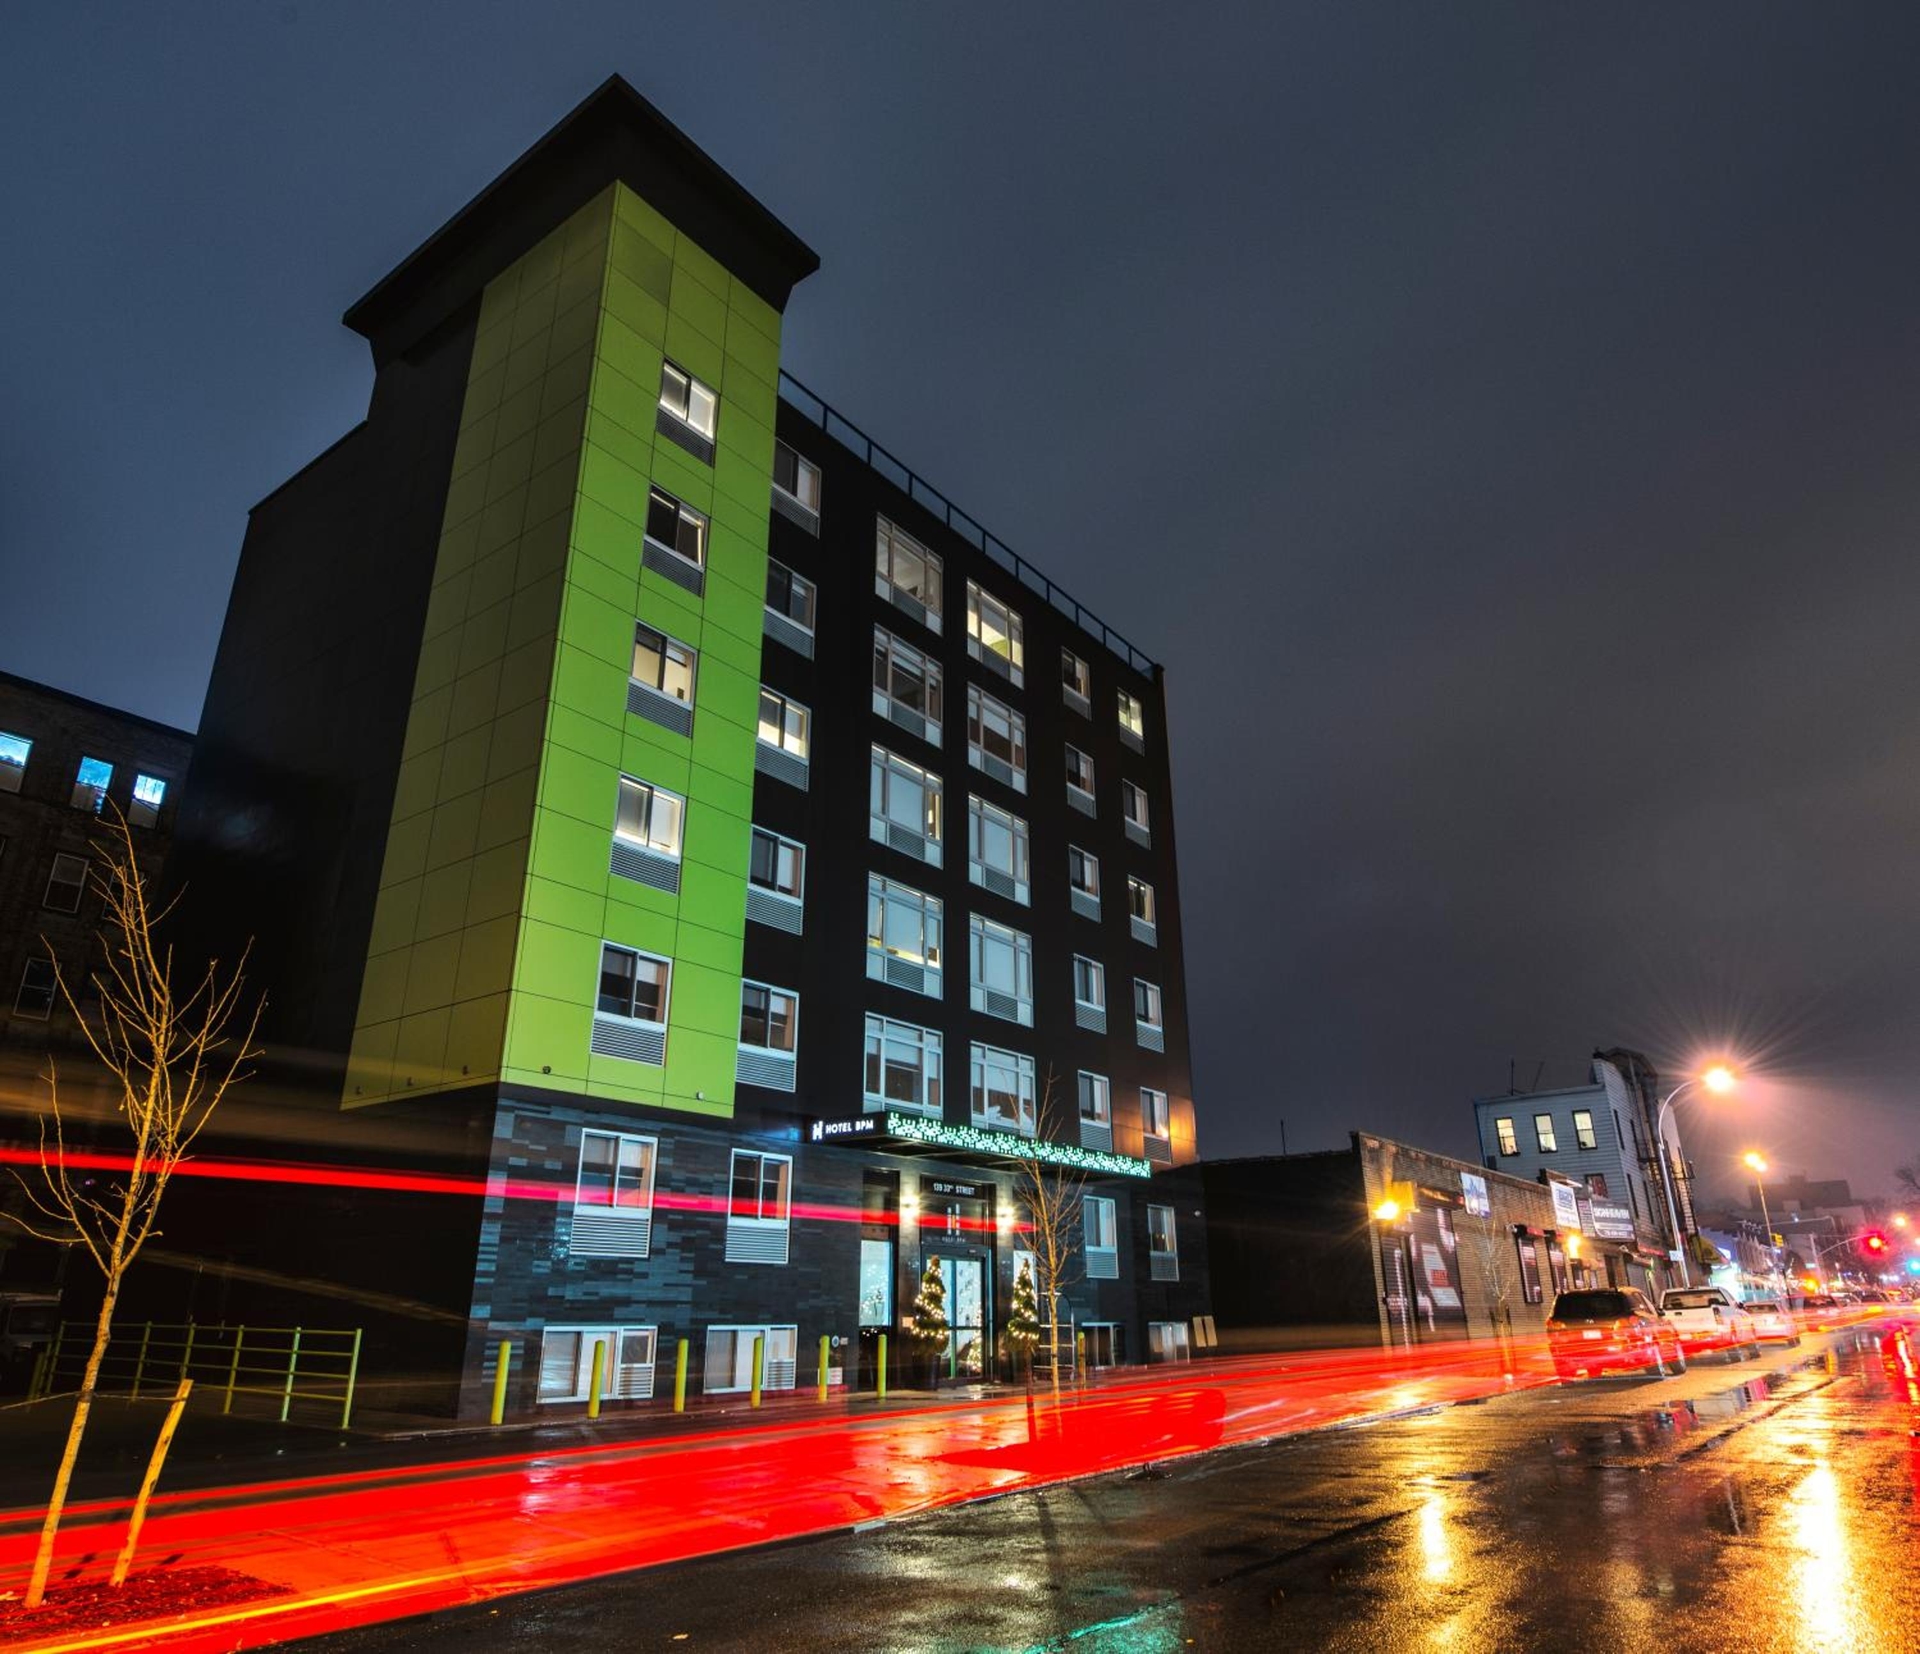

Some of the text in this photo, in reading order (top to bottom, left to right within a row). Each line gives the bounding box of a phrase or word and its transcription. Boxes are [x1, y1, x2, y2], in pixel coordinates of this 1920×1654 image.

[825, 1122, 852, 1134] HOTEL
[855, 1119, 874, 1131] BPM
[955, 1185, 975, 1196] STREET
